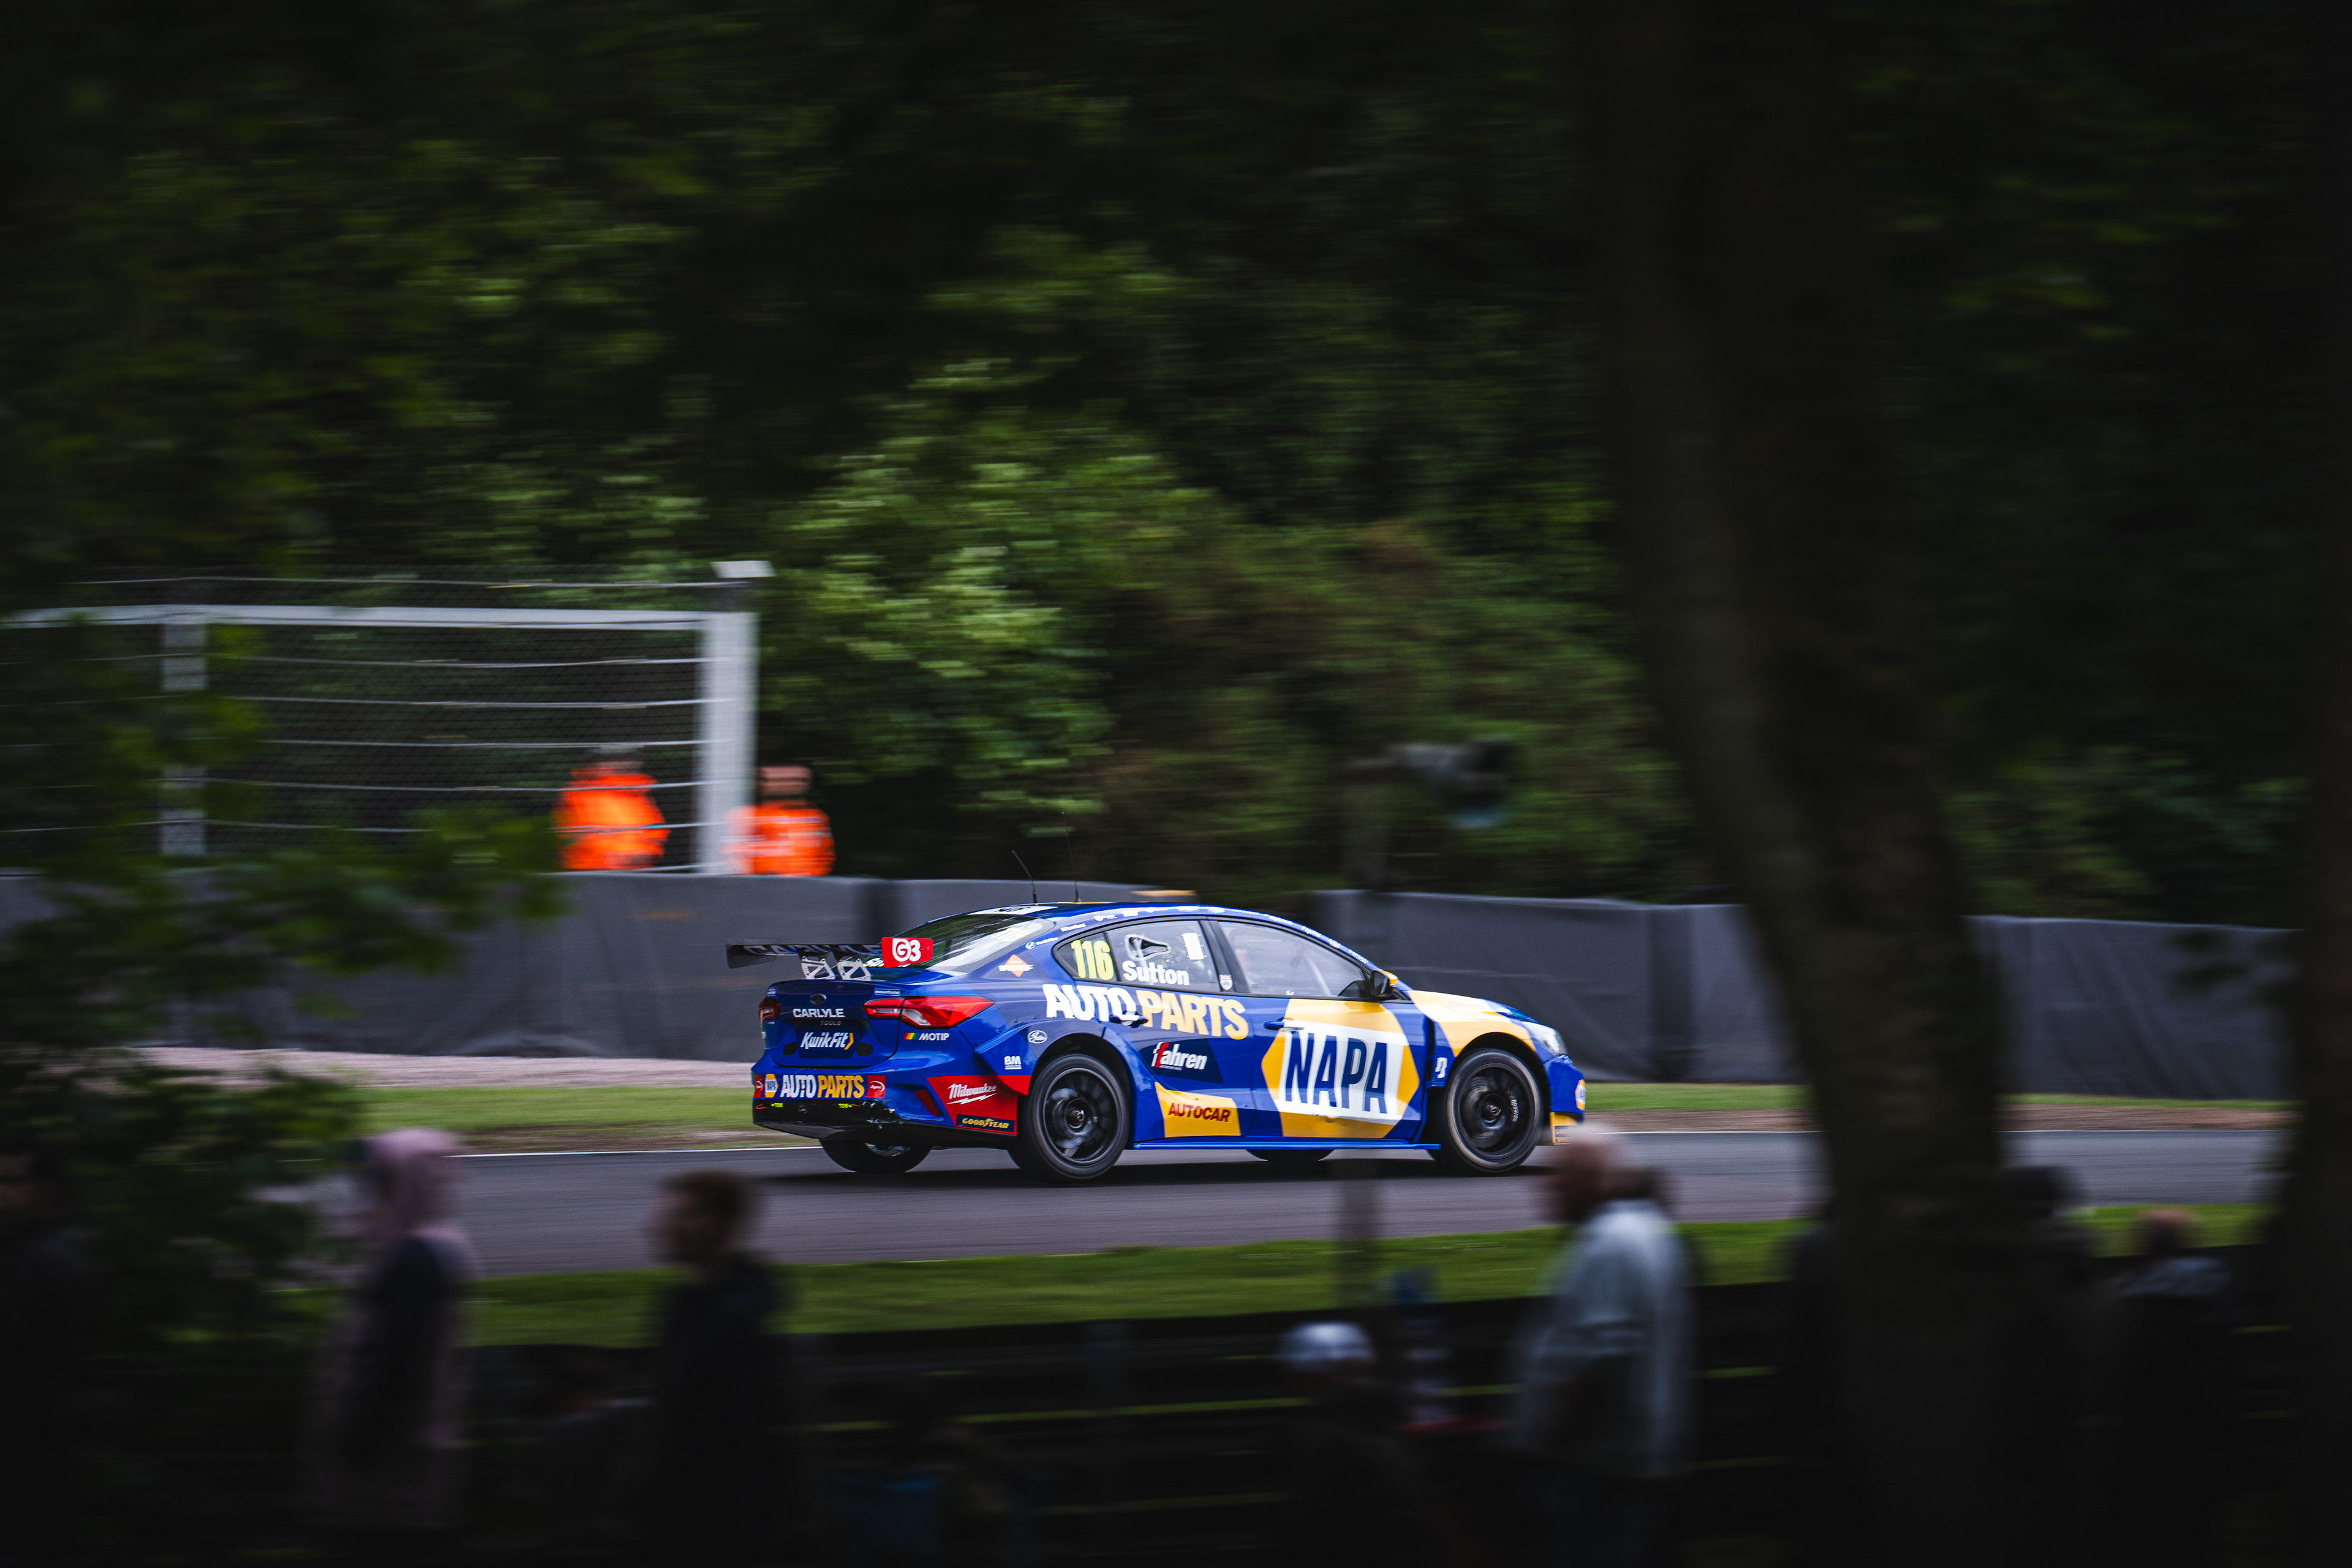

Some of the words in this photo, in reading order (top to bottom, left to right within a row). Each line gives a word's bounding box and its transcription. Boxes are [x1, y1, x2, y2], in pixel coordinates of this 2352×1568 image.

[1071, 939, 1114, 981] 116
[1122, 960, 1189, 986] Sutton
[793, 1008, 846, 1018] CARLYLE
[1042, 984, 1137, 1025] AUTO
[1136, 990, 1249, 1040] PARTS
[1004, 1055, 1022, 1065] BM
[1286, 1031, 1387, 1114] NAPA
[780, 1074, 817, 1098] AUTO
[816, 1074, 865, 1098] PARTS
[947, 1082, 998, 1099] Milwaukee
[962, 1117, 1009, 1129] GOODYEAR
[1168, 1102, 1231, 1122] AUTOCAR
